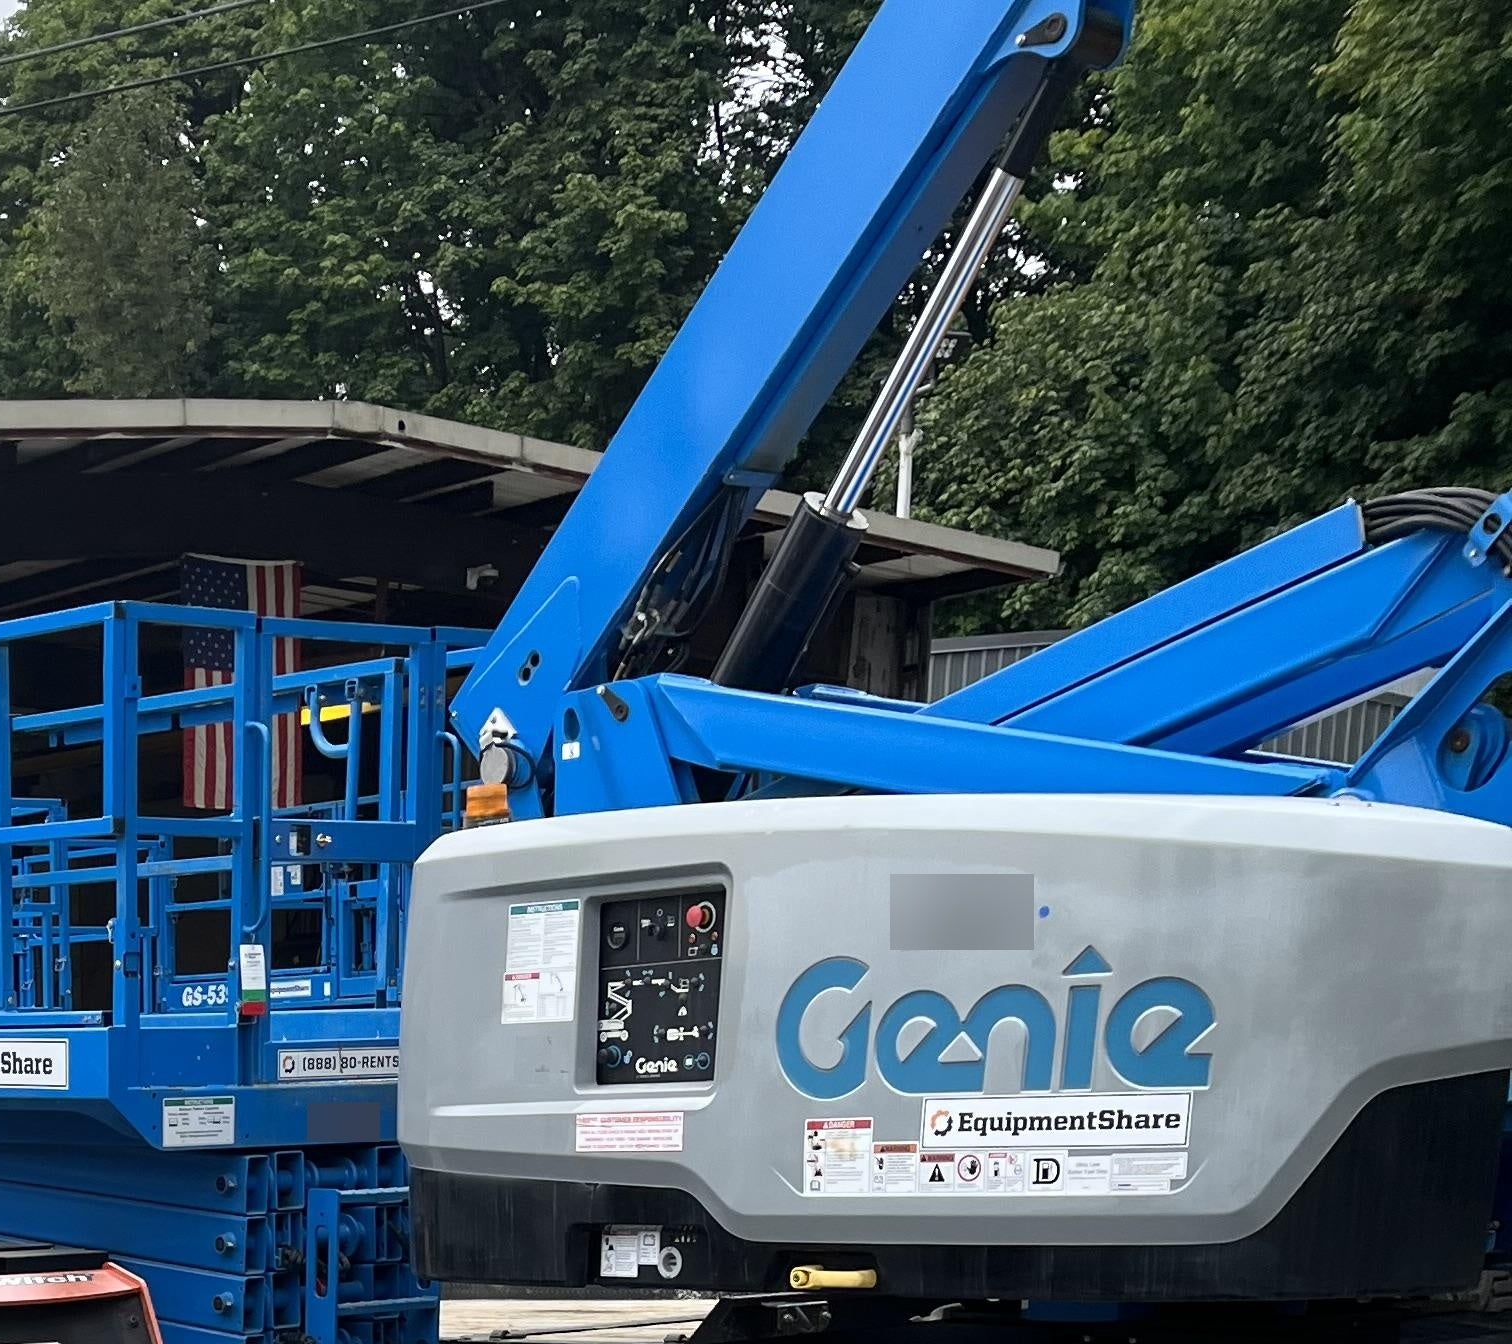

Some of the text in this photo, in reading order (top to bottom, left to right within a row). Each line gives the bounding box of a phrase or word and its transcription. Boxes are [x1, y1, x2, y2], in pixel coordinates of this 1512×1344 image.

[182, 984, 228, 1007] GS-53
[776, 945, 1217, 1101] Genie
[303, 1056, 336, 1071] (888)
[635, 1056, 678, 1074] Genie
[829, 1120, 855, 1128] DANGER
[958, 1109, 1181, 1136] EquipmentShare
